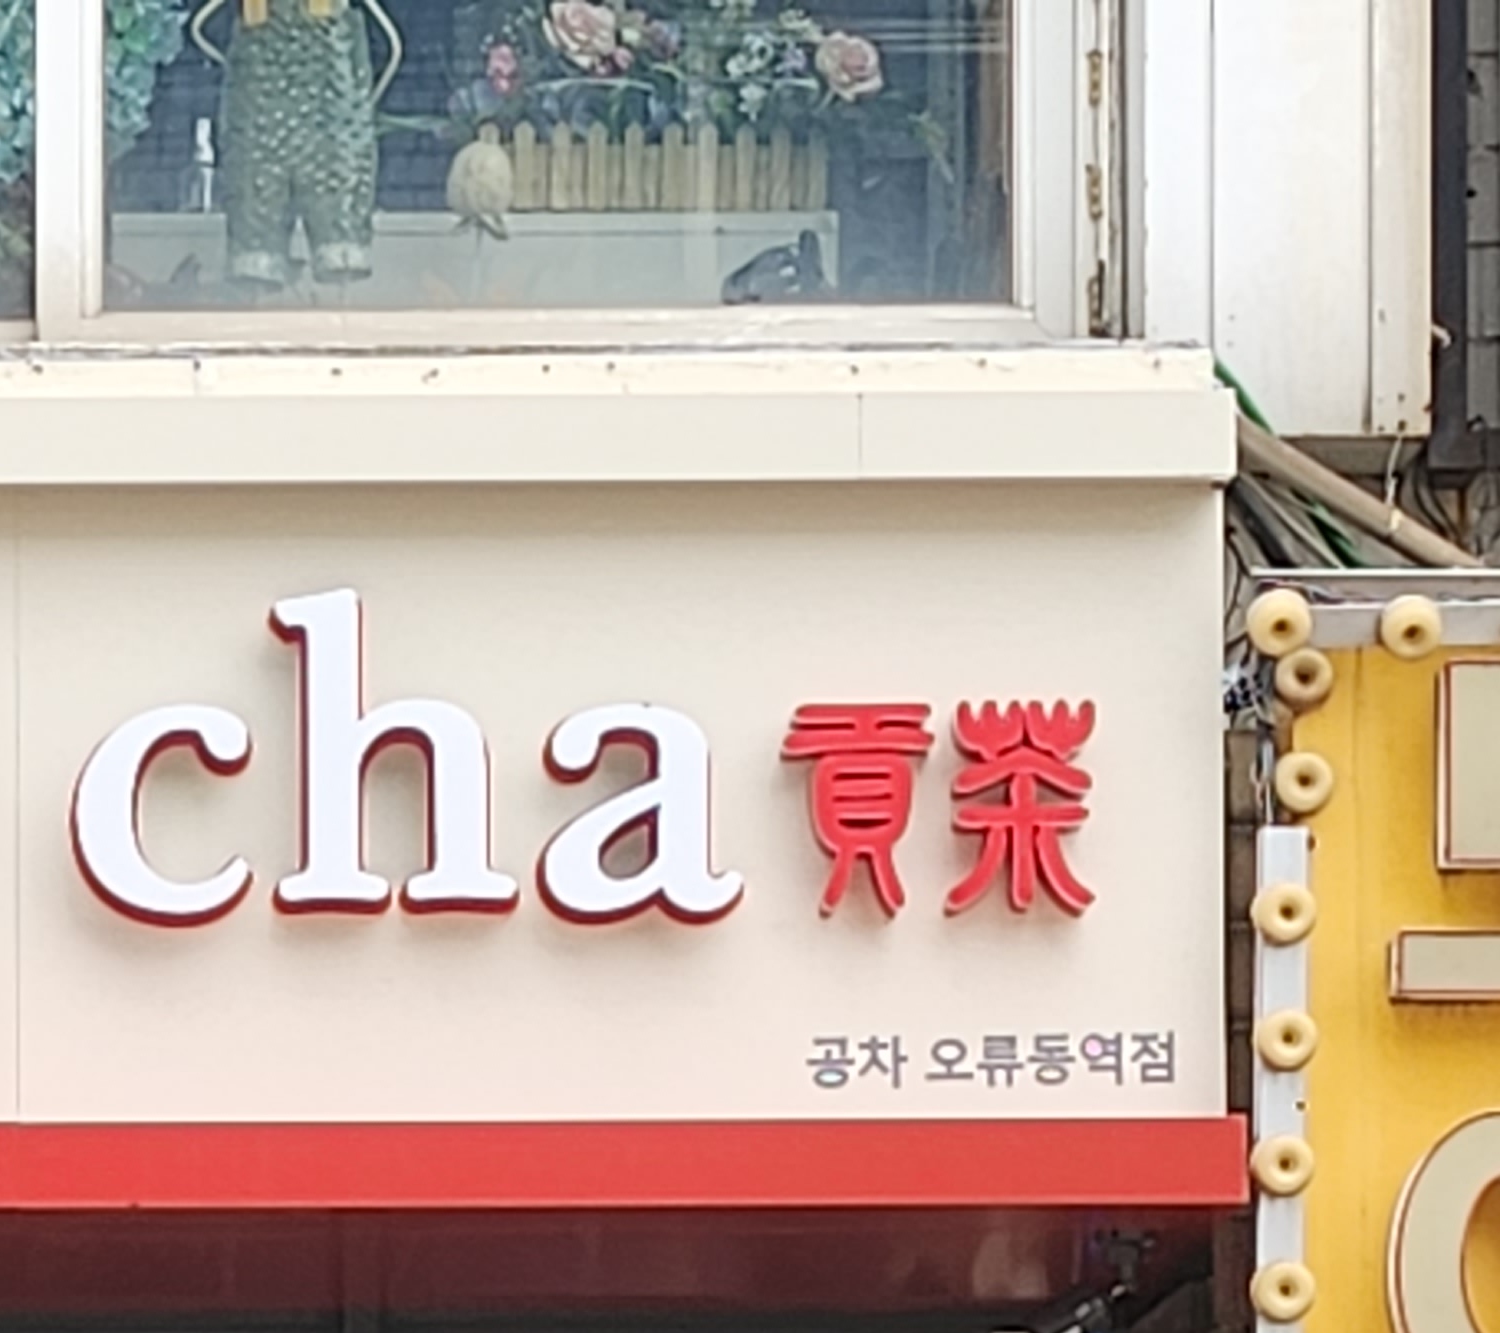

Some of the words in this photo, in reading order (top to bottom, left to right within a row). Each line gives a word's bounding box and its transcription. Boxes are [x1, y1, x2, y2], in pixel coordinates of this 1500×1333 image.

[69, 587, 744, 928] cha
[780, 698, 1098, 918] 貢茶
[806, 1033, 905, 1088] 공차
[925, 1029, 1179, 1087] 오류동역점
